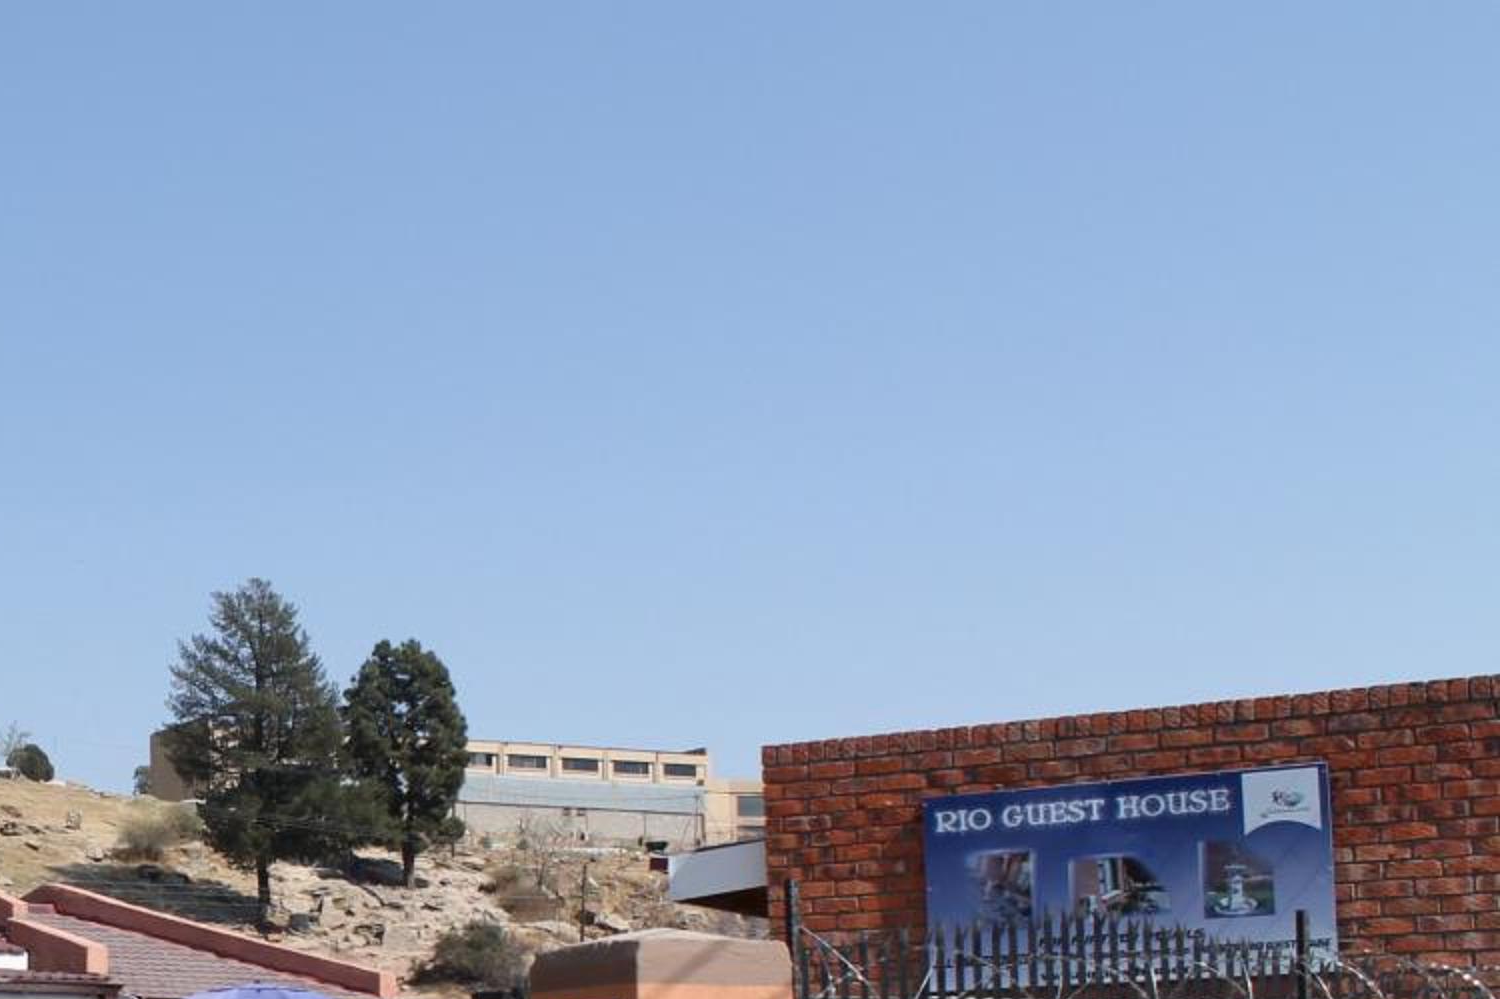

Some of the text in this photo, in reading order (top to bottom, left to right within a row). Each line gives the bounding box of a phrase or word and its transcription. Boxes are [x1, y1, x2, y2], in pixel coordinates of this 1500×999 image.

[934, 808, 992, 834] RIO
[1001, 799, 1105, 828] GUEST
[1116, 789, 1231, 819] HOUSE
